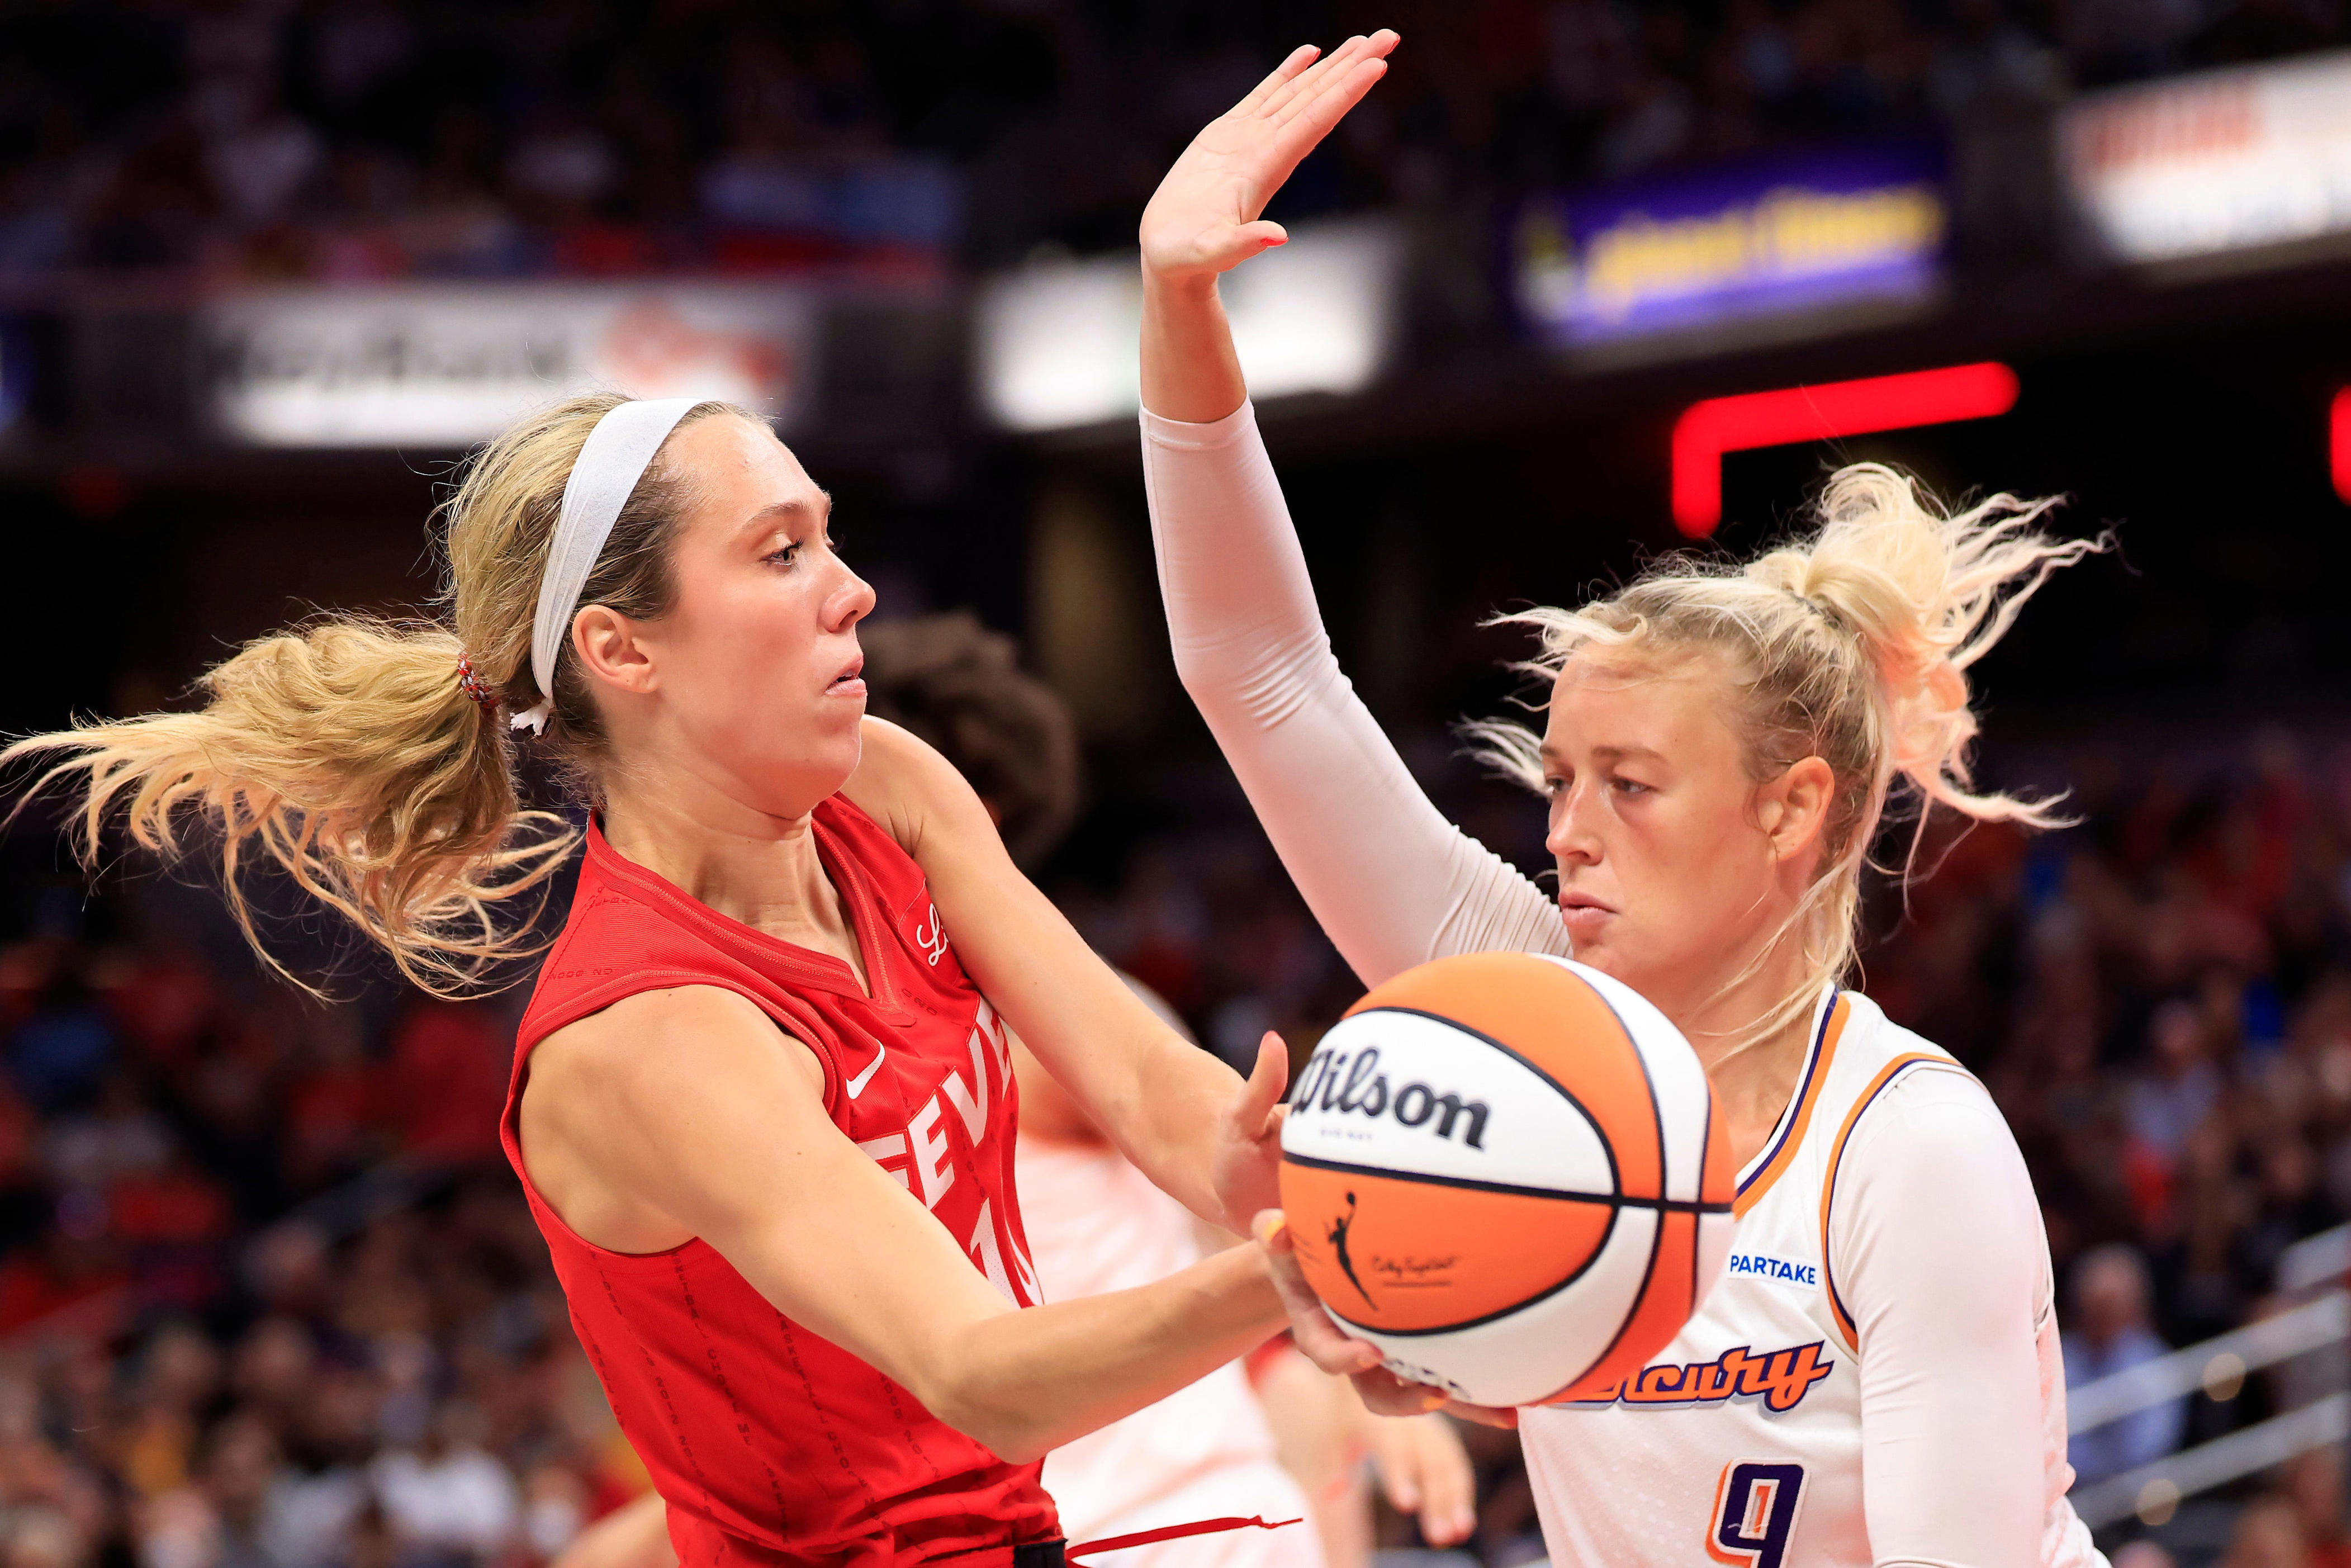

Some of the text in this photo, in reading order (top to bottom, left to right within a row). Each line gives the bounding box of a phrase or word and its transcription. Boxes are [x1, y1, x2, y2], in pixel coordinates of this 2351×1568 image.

[1729, 1254, 1816, 1285] PARTAKE
[1582, 1339, 1835, 1414] cury
[1706, 1458, 1811, 1568] 9
